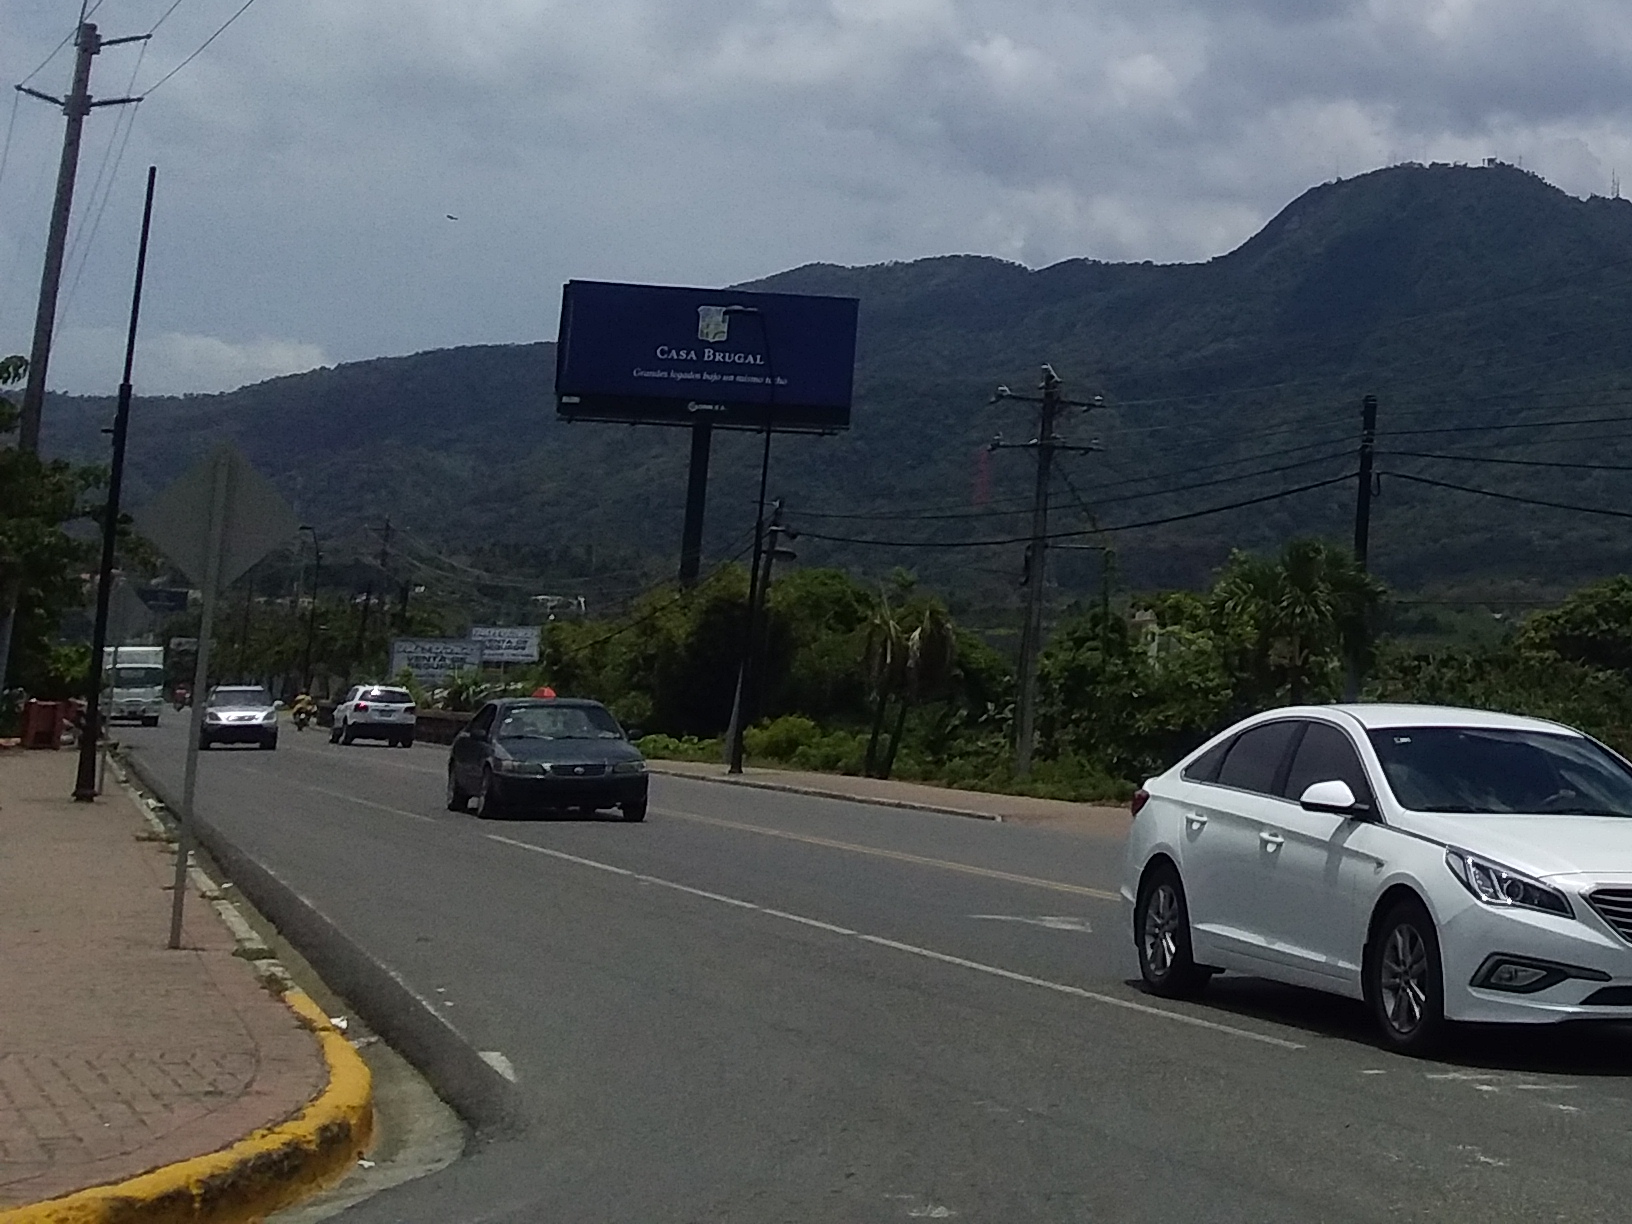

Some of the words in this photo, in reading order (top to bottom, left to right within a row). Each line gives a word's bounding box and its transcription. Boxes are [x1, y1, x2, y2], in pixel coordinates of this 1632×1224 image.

[656, 345, 698, 361] CASA
[703, 348, 765, 365] BRUGAL
[632, 367, 668, 378] Grandes
[702, 371, 721, 383] bajo
